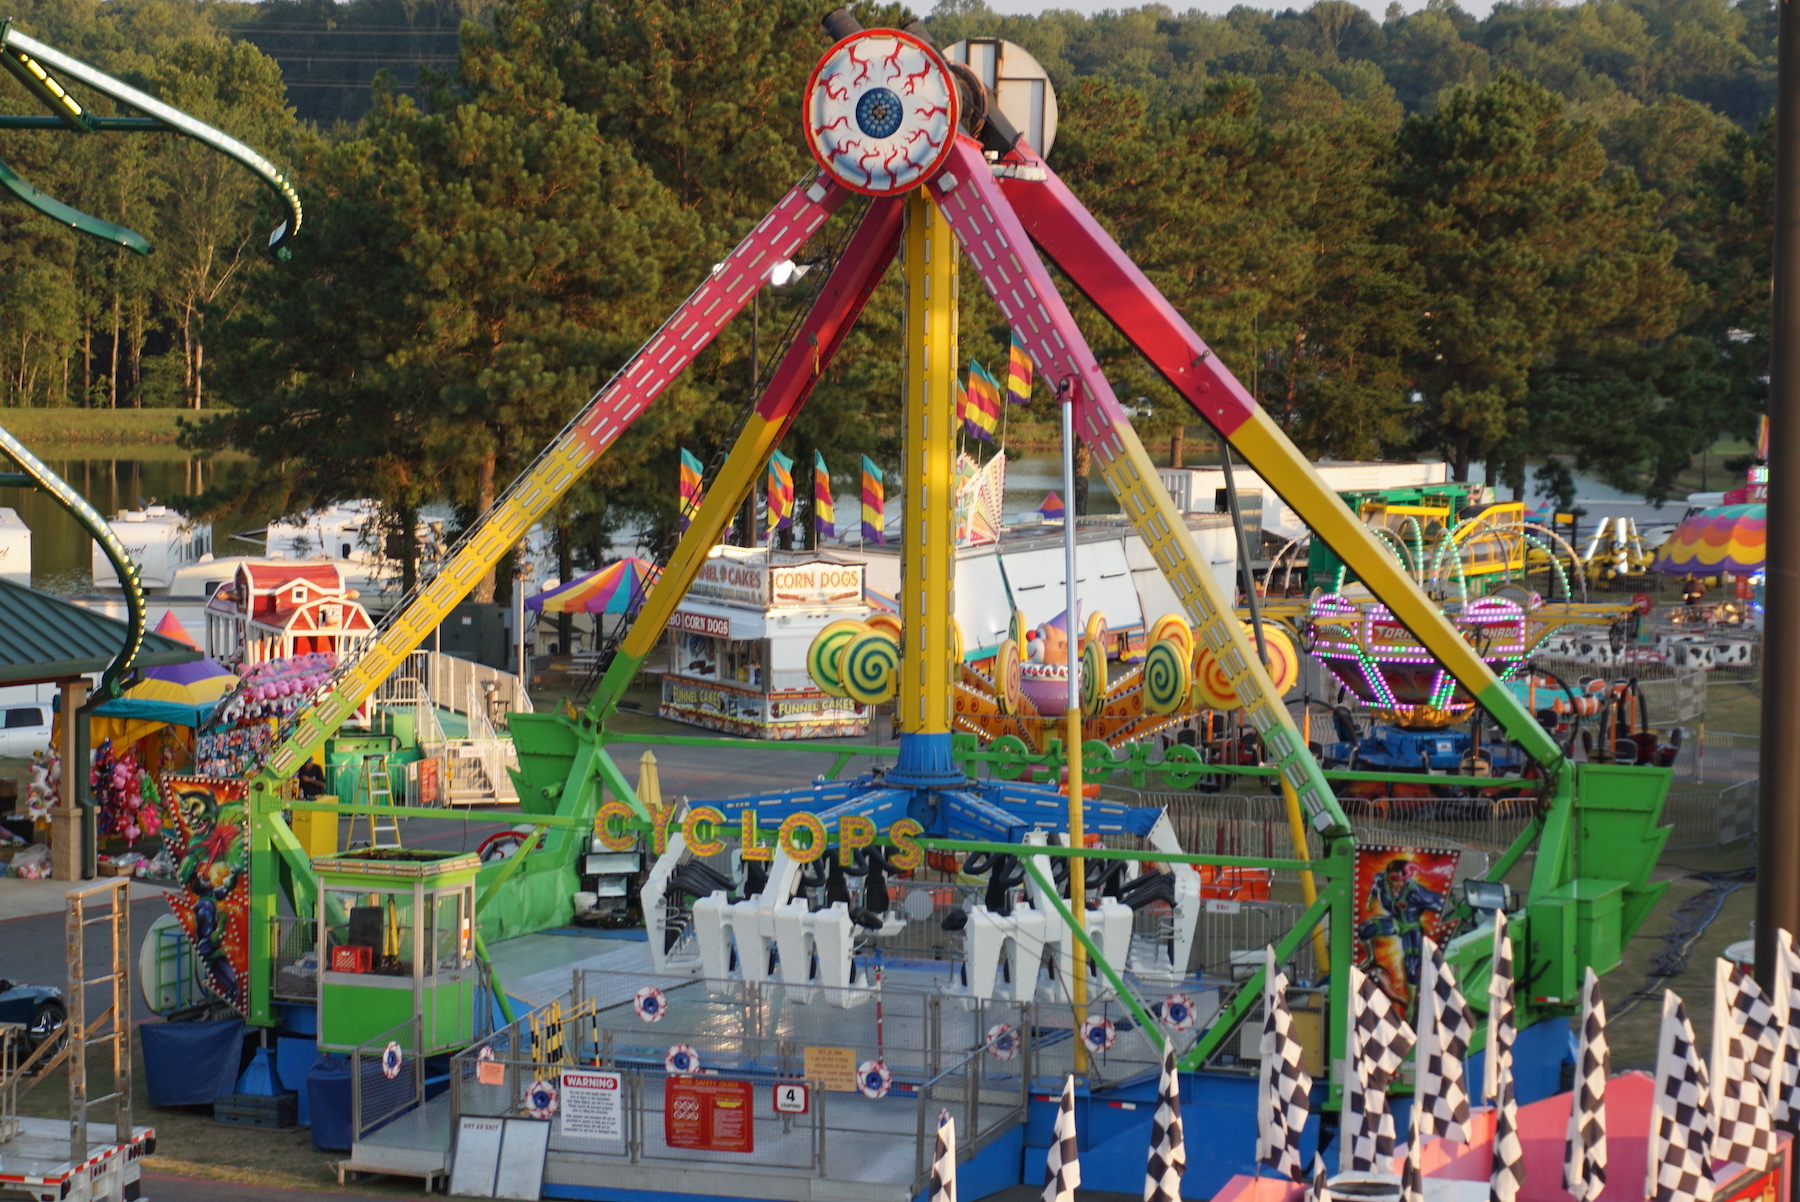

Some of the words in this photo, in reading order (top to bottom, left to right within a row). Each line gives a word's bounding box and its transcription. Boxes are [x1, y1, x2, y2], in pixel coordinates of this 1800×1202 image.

[728, 566, 762, 590] CAKES
[775, 572, 815, 589] CORN
[820, 570, 858, 589] DOGS
[685, 615, 706, 630] CORN
[707, 618, 729, 635] DOGS
[673, 685, 698, 703] FUNNEL
[700, 690, 722, 713] CAKES
[778, 703, 818, 715] FUNNEL
[822, 698, 855, 711] CAKES
[594, 801, 926, 871] CYCLOPS
[566, 1076, 614, 1089] WARNING
[786, 1088, 796, 1102] 4
